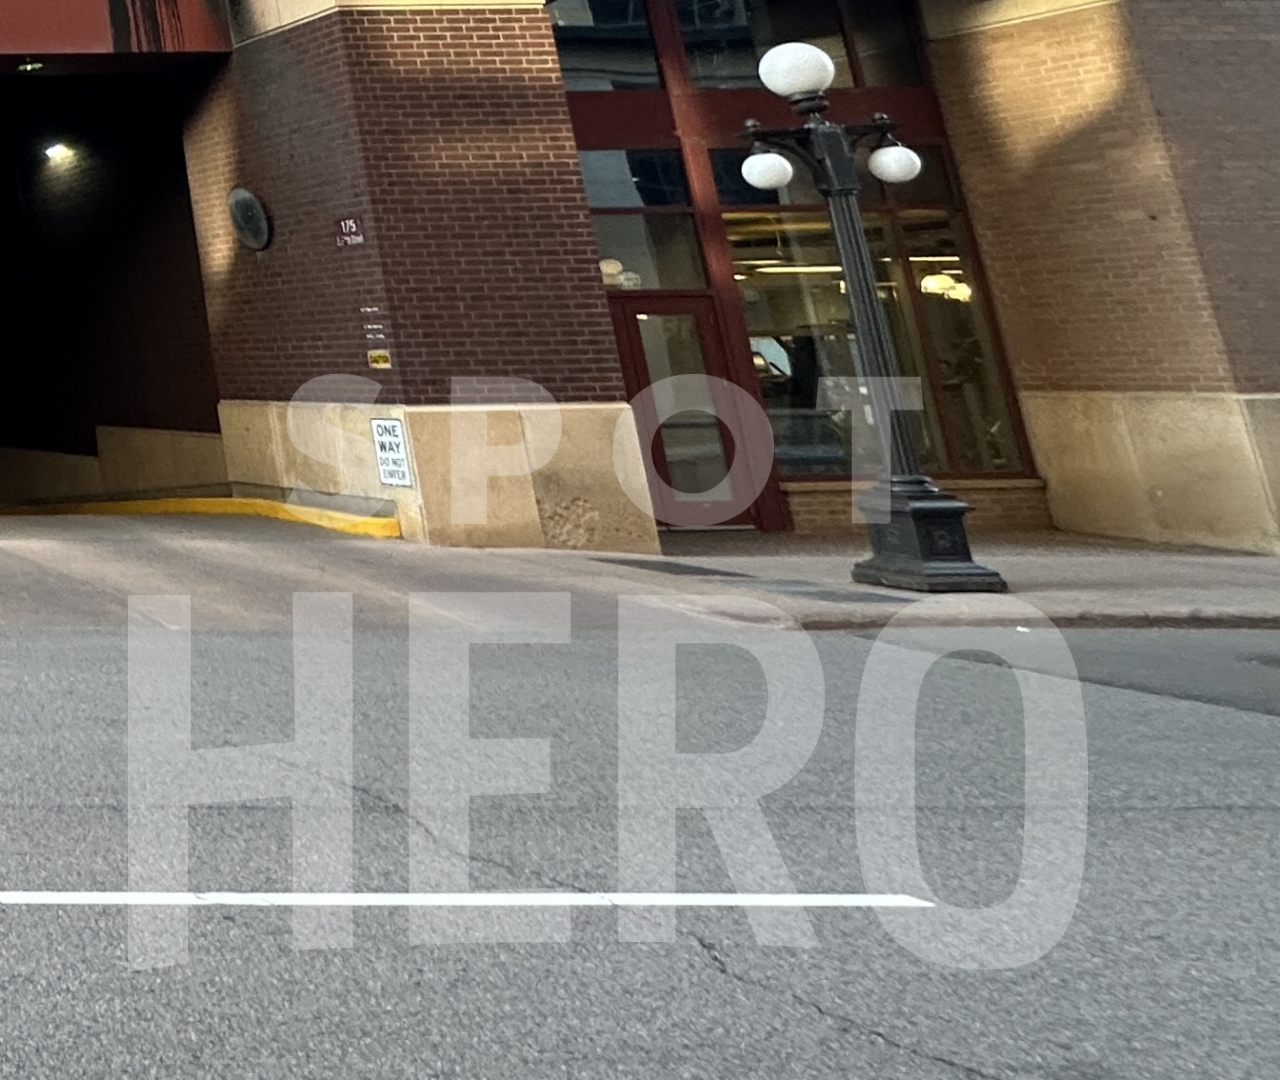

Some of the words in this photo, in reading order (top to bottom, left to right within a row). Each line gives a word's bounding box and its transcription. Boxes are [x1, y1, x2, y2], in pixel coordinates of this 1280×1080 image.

[340, 219, 357, 233] 175
[376, 424, 399, 438] ONE
[378, 440, 401, 454] WAY
[380, 456, 389, 467] DO
[391, 458, 405, 468] NOT
[383, 468, 406, 481] ENTER
